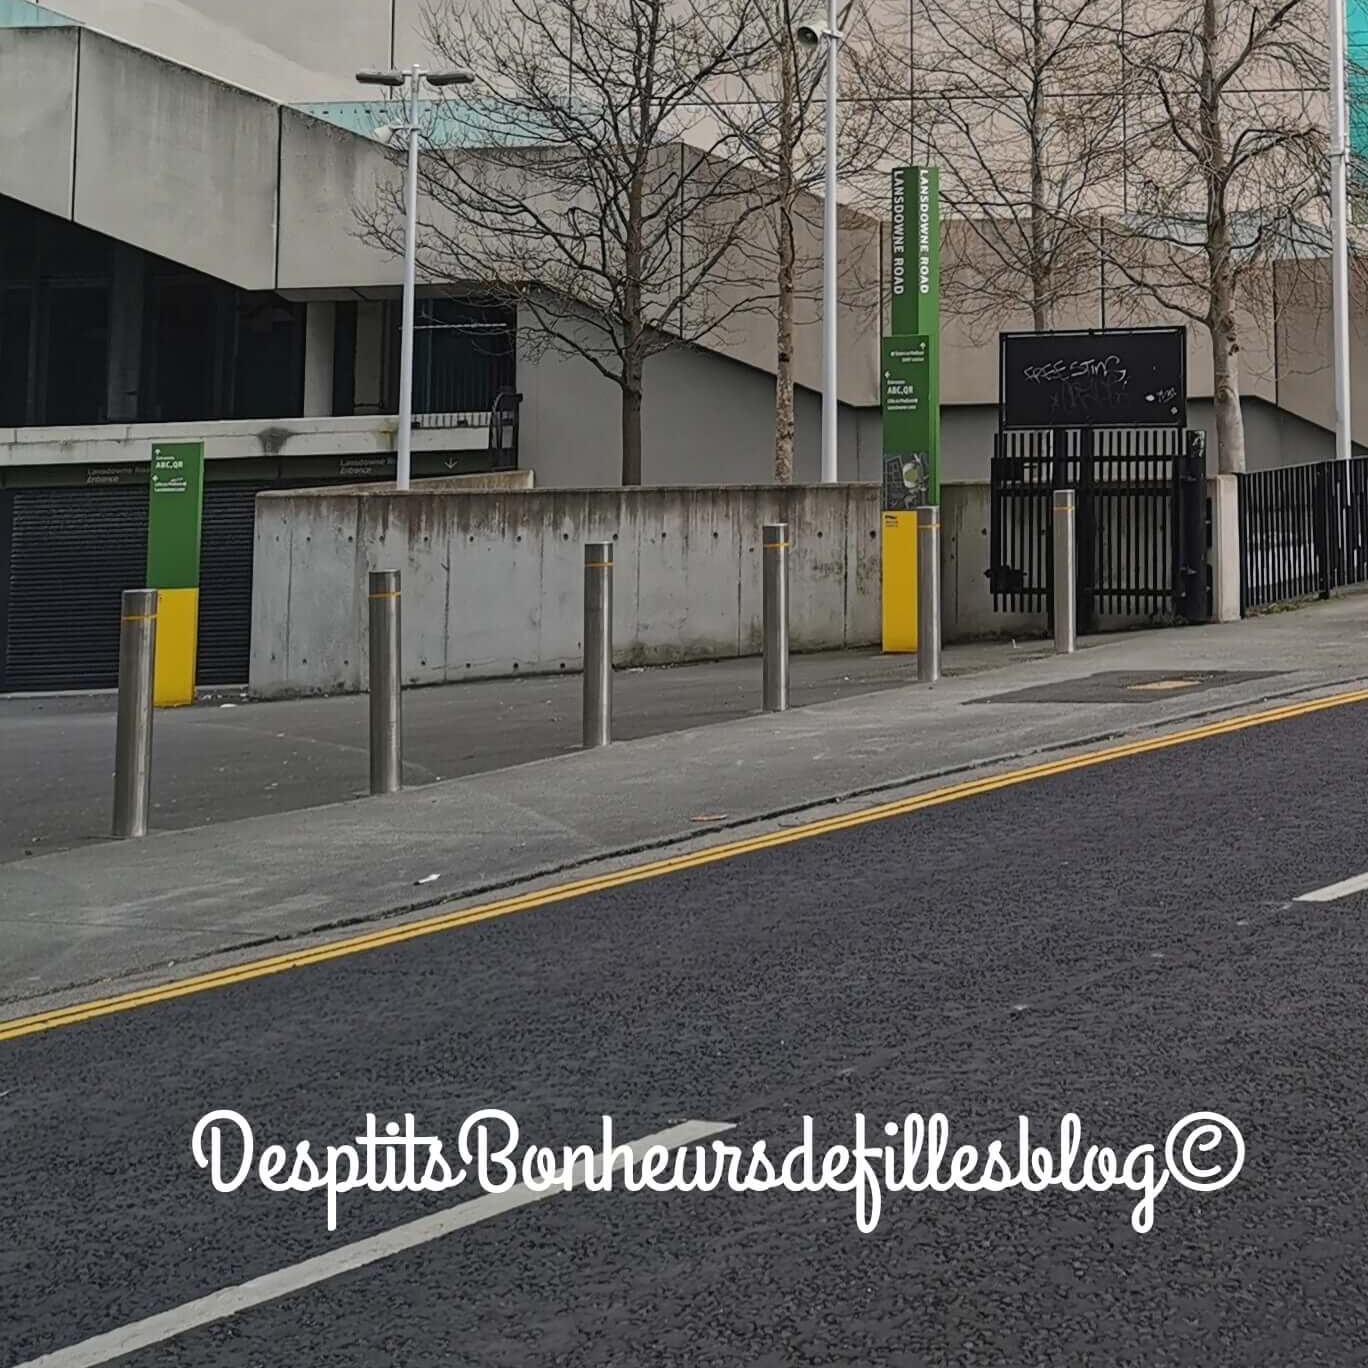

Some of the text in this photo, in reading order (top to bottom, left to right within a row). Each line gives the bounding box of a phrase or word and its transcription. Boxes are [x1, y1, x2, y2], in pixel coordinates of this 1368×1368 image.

[893, 170, 905, 295] LANSDOWNE ROAD
[919, 169, 929, 294] LANSDOWNE ROAD
